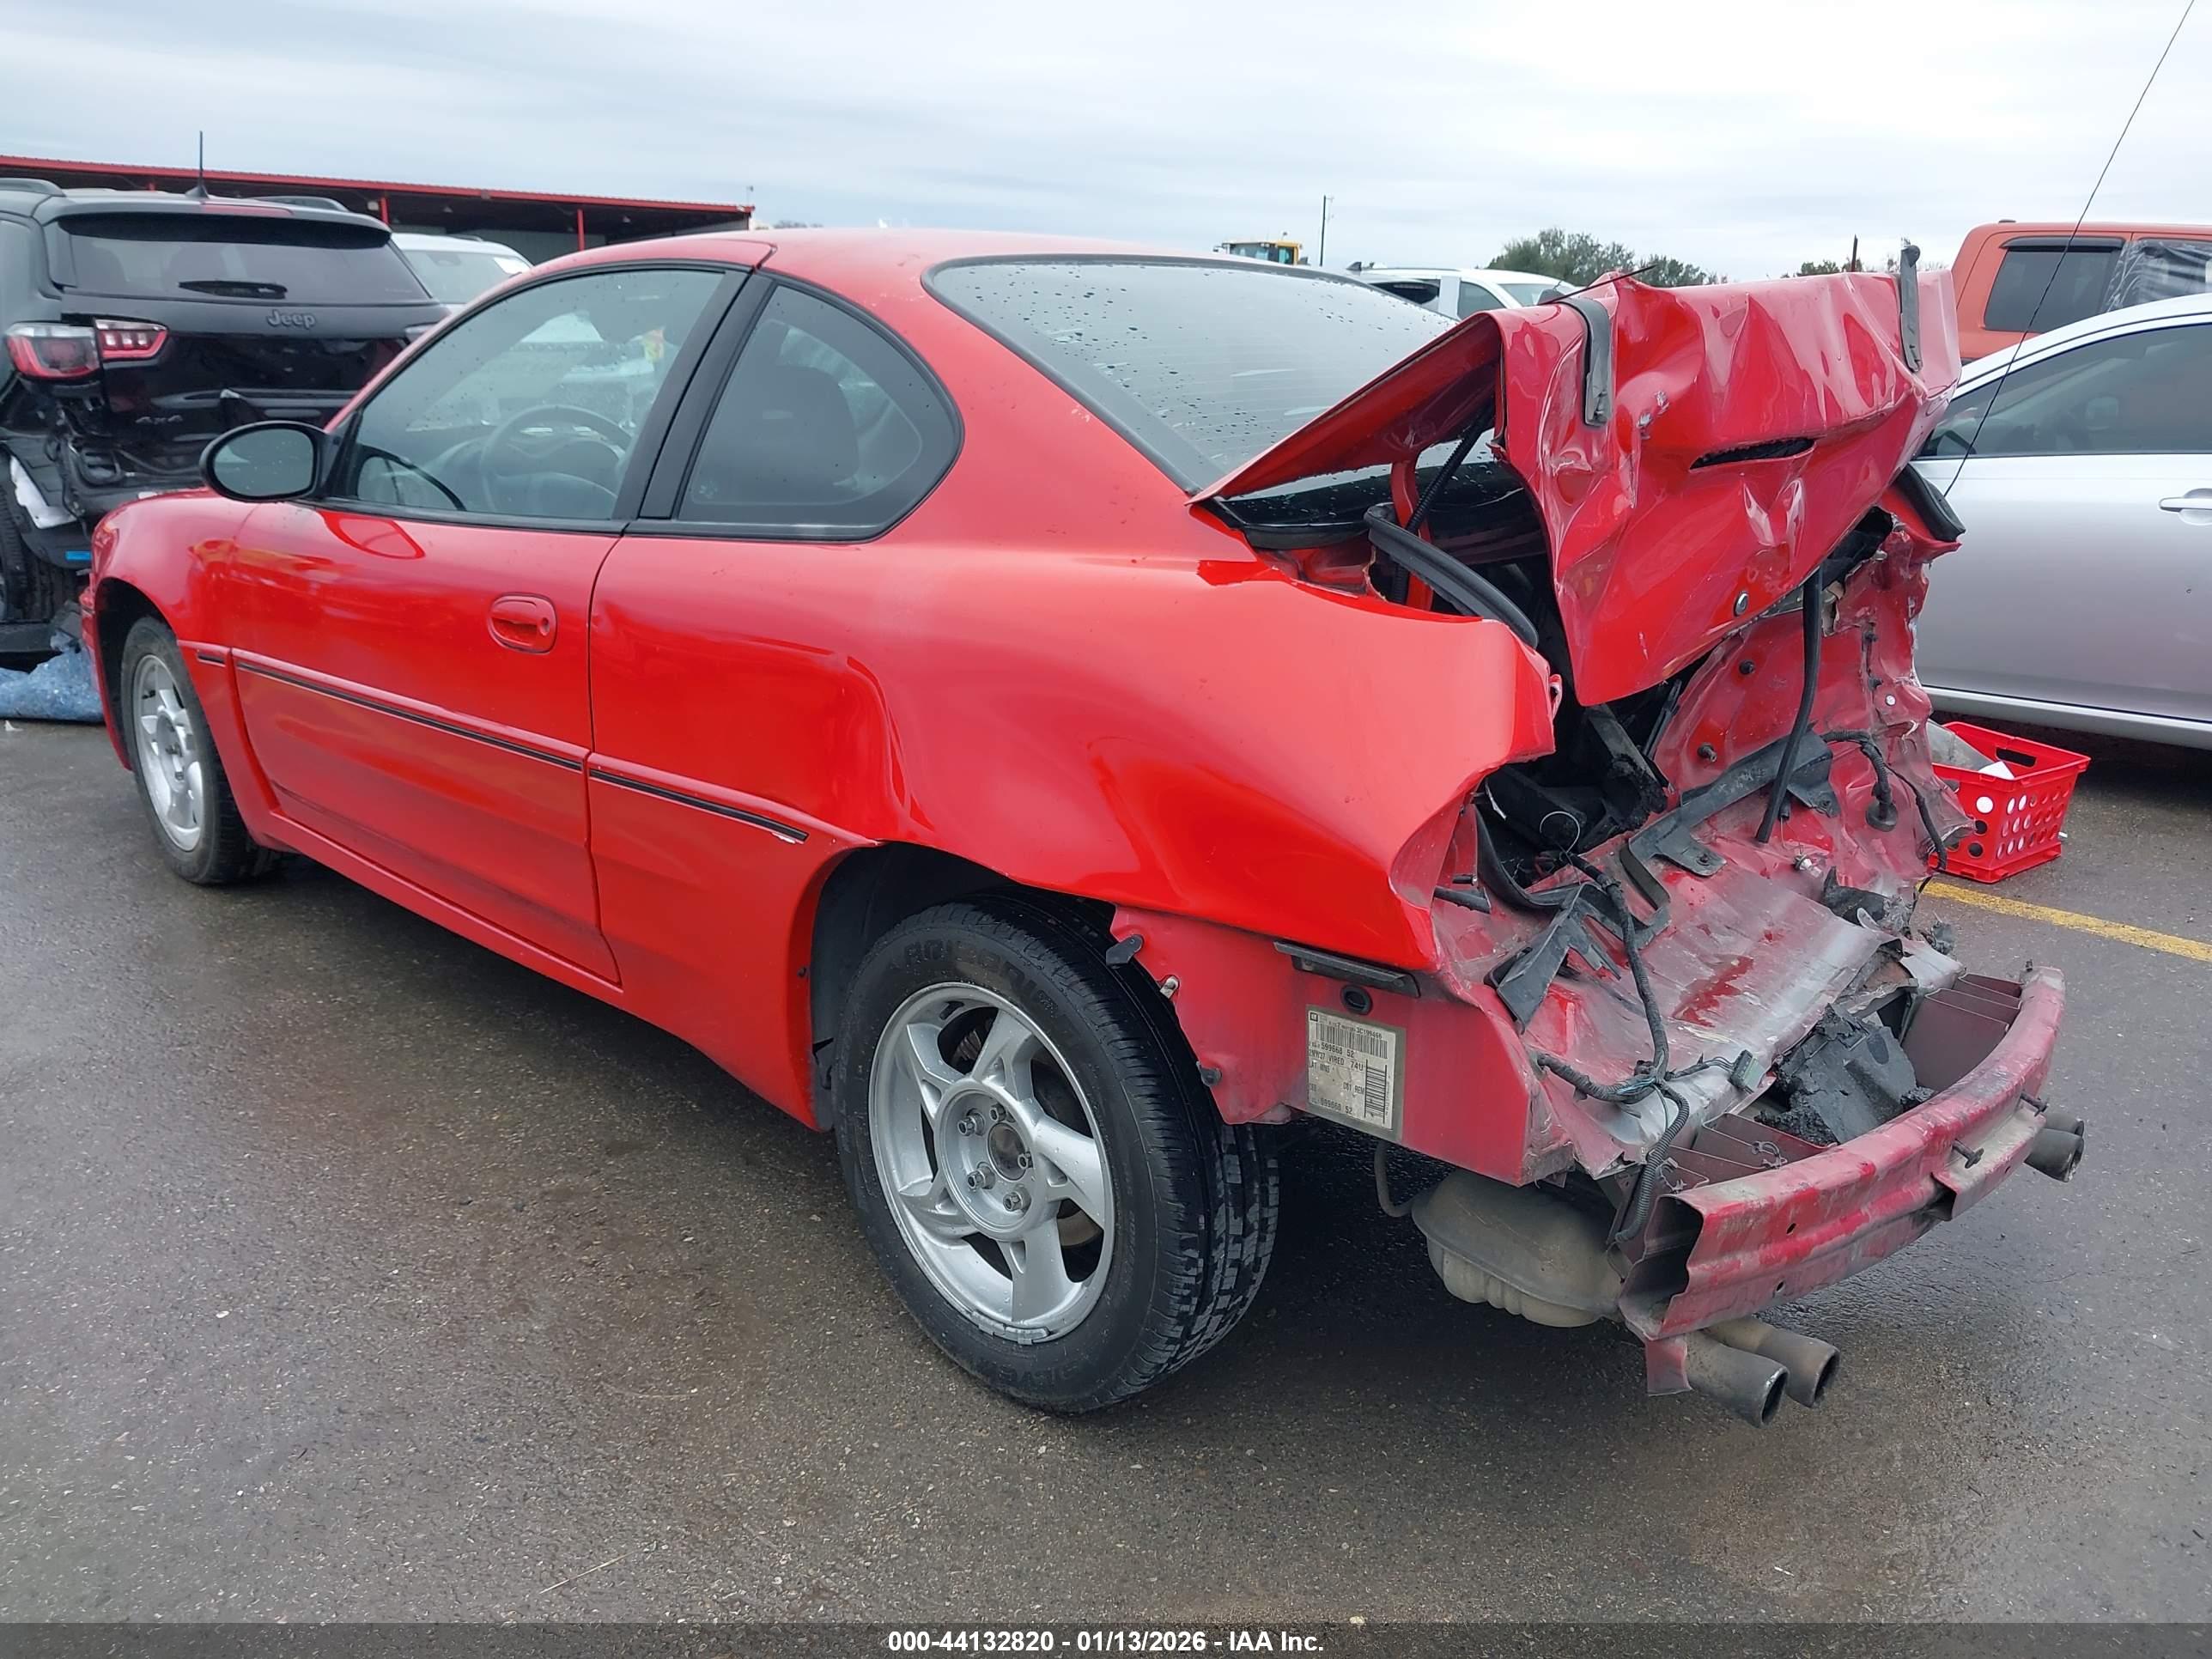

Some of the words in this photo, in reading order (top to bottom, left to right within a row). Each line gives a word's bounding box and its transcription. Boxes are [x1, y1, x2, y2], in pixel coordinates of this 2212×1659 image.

[265, 309, 317, 330] Jeep
[1346, 1048, 1354, 1059] 52
[1350, 1060, 1364, 1072] 74U
[1345, 1105, 1353, 1115] 52
